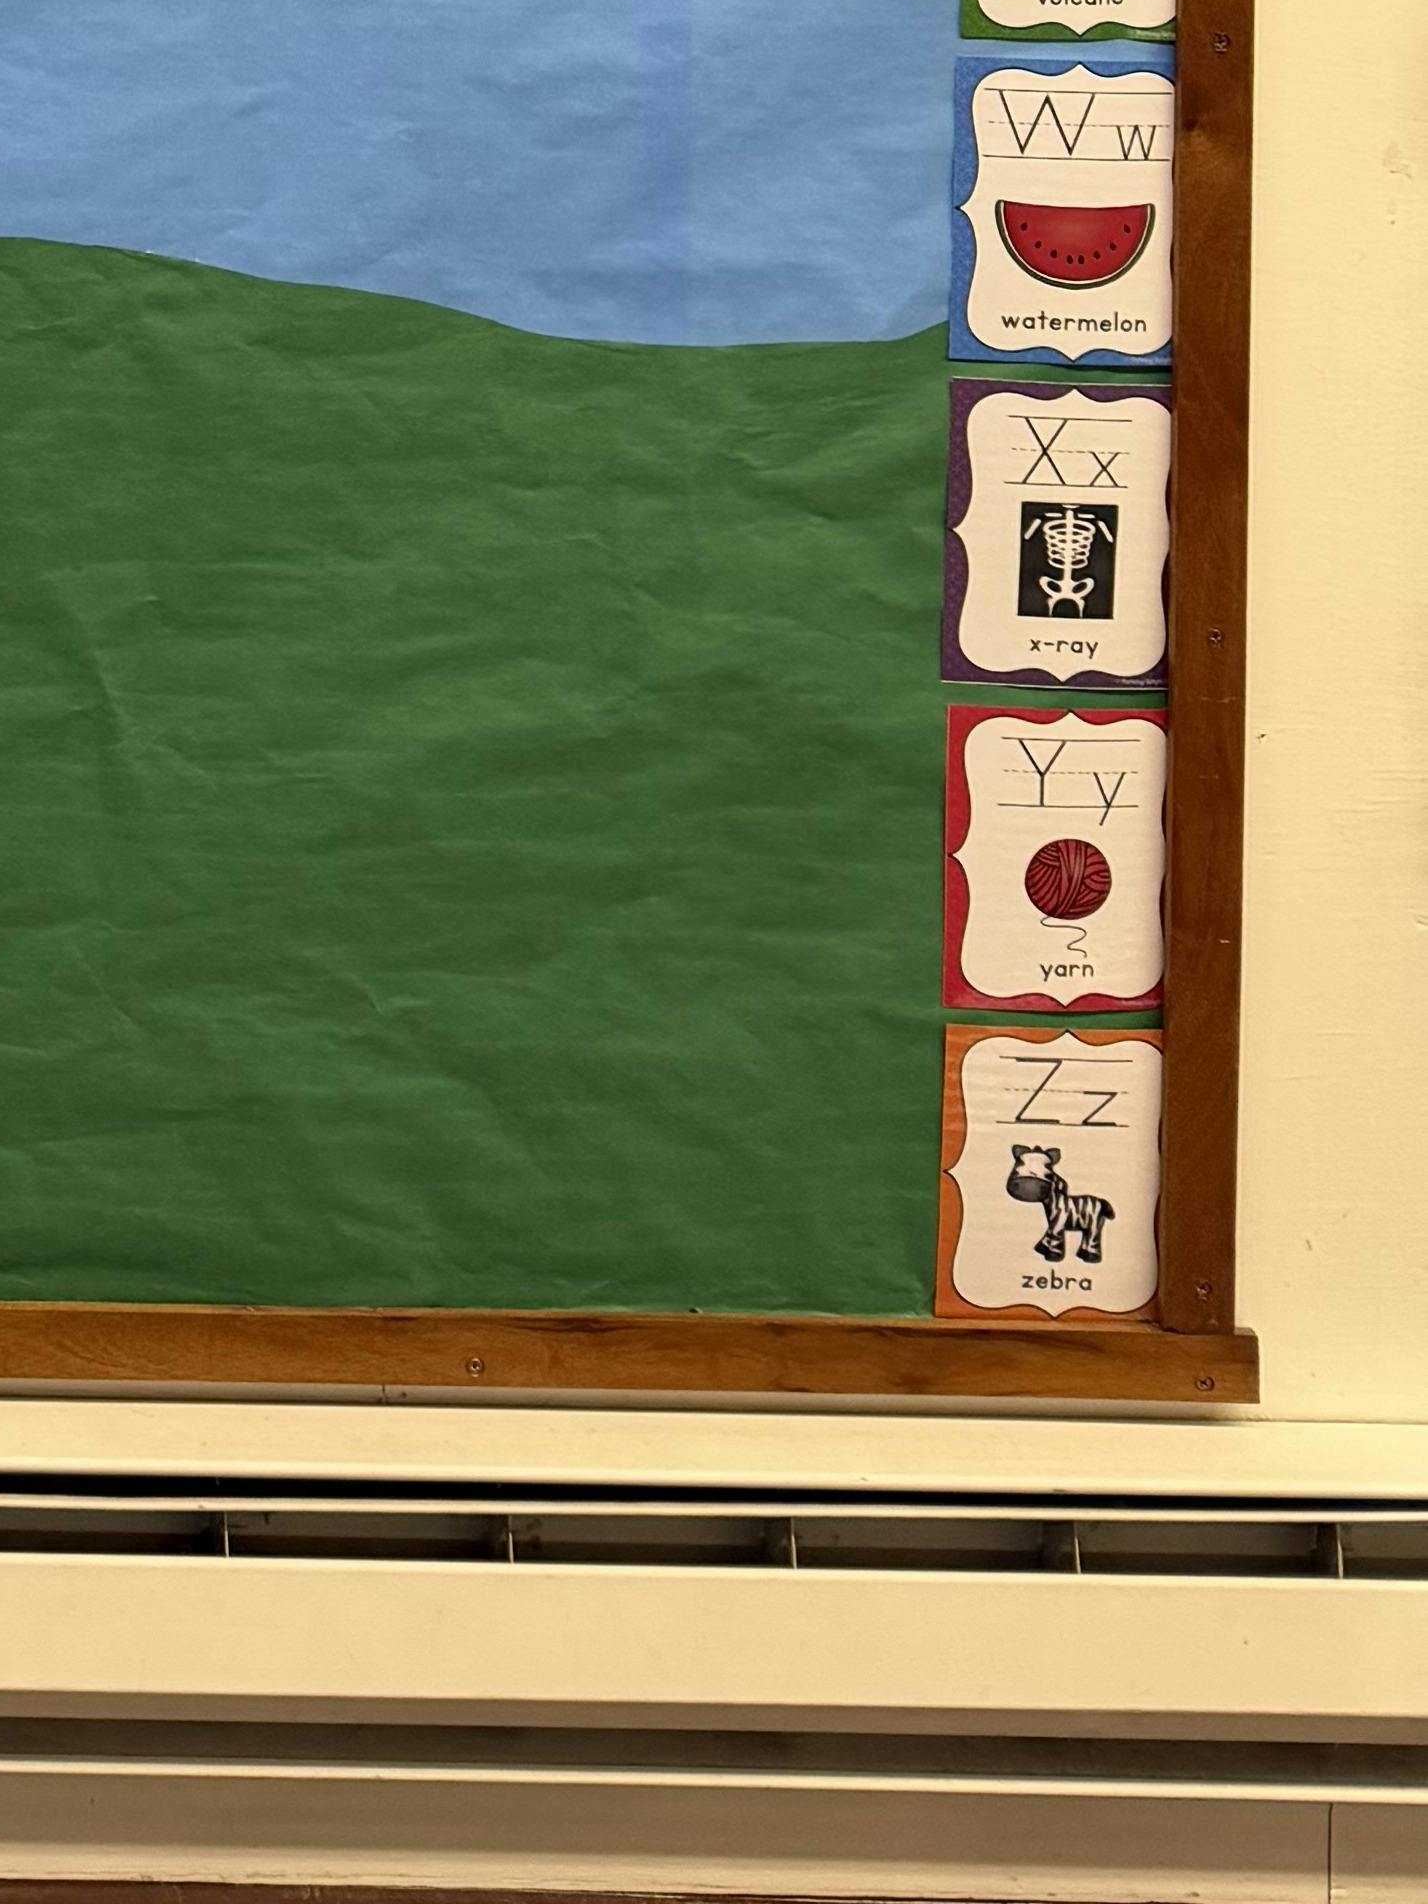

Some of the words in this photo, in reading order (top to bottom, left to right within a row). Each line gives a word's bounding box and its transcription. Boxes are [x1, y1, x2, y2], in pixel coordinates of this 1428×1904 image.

[998, 90, 1157, 161] Ww
[1000, 309, 1148, 334] watermelon
[1022, 417, 1119, 487] Xx
[1029, 638, 1100, 661] x-ray
[1018, 739, 1126, 826] Yy
[1038, 962, 1095, 984] yarn
[1015, 1057, 1117, 1127] Zz
[1020, 1267, 1093, 1292] zebra
